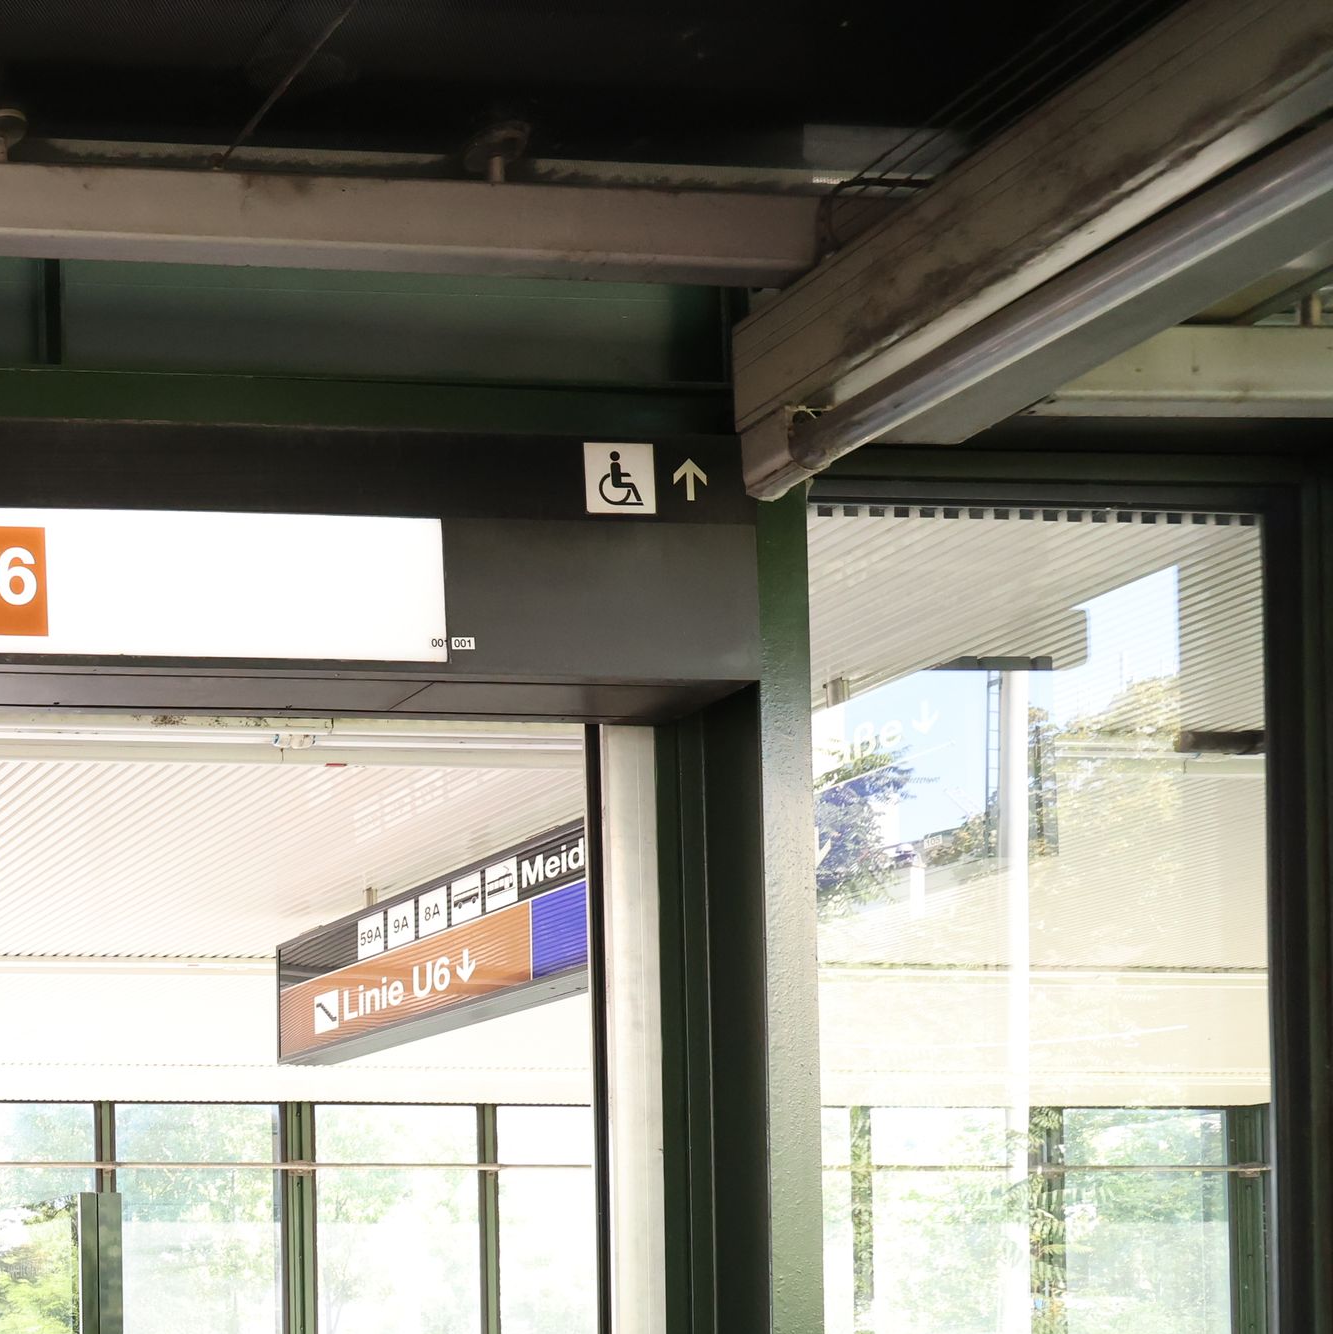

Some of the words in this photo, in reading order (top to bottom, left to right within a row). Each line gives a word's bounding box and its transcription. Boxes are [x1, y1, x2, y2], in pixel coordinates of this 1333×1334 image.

[454, 638, 472, 648] 001
[360, 925, 382, 947] 59A
[393, 915, 409, 934] 9A
[424, 902, 441, 921] 8A
[520, 838, 585, 888] Meid
[343, 976, 405, 1022] Linie
[412, 956, 451, 999] U6
